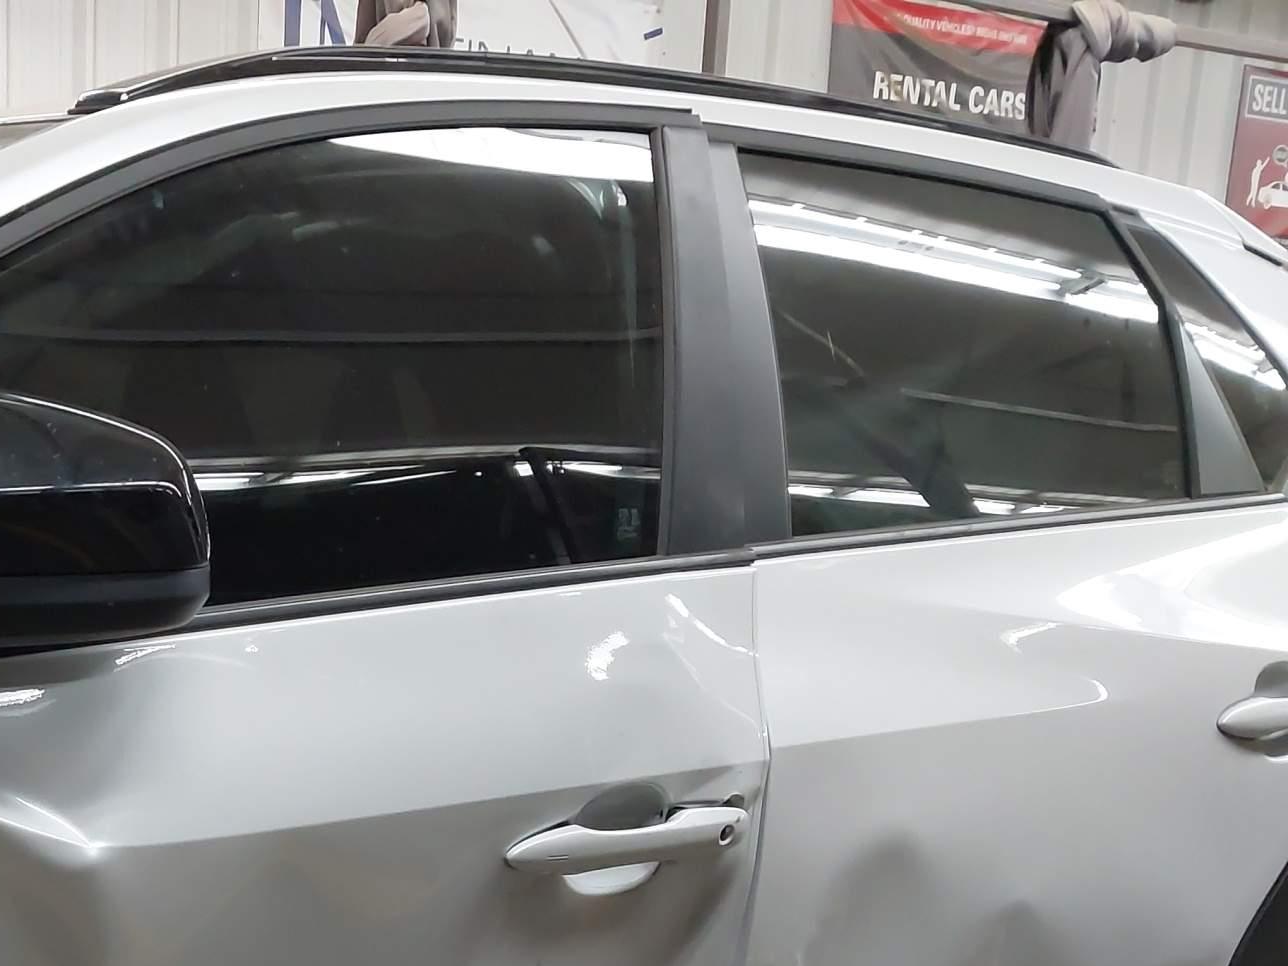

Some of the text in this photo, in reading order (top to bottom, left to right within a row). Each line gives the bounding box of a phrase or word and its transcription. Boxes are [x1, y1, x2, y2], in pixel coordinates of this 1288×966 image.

[873, 71, 1026, 120] RENTAL CARS
[1252, 84, 1287, 115] SELL
